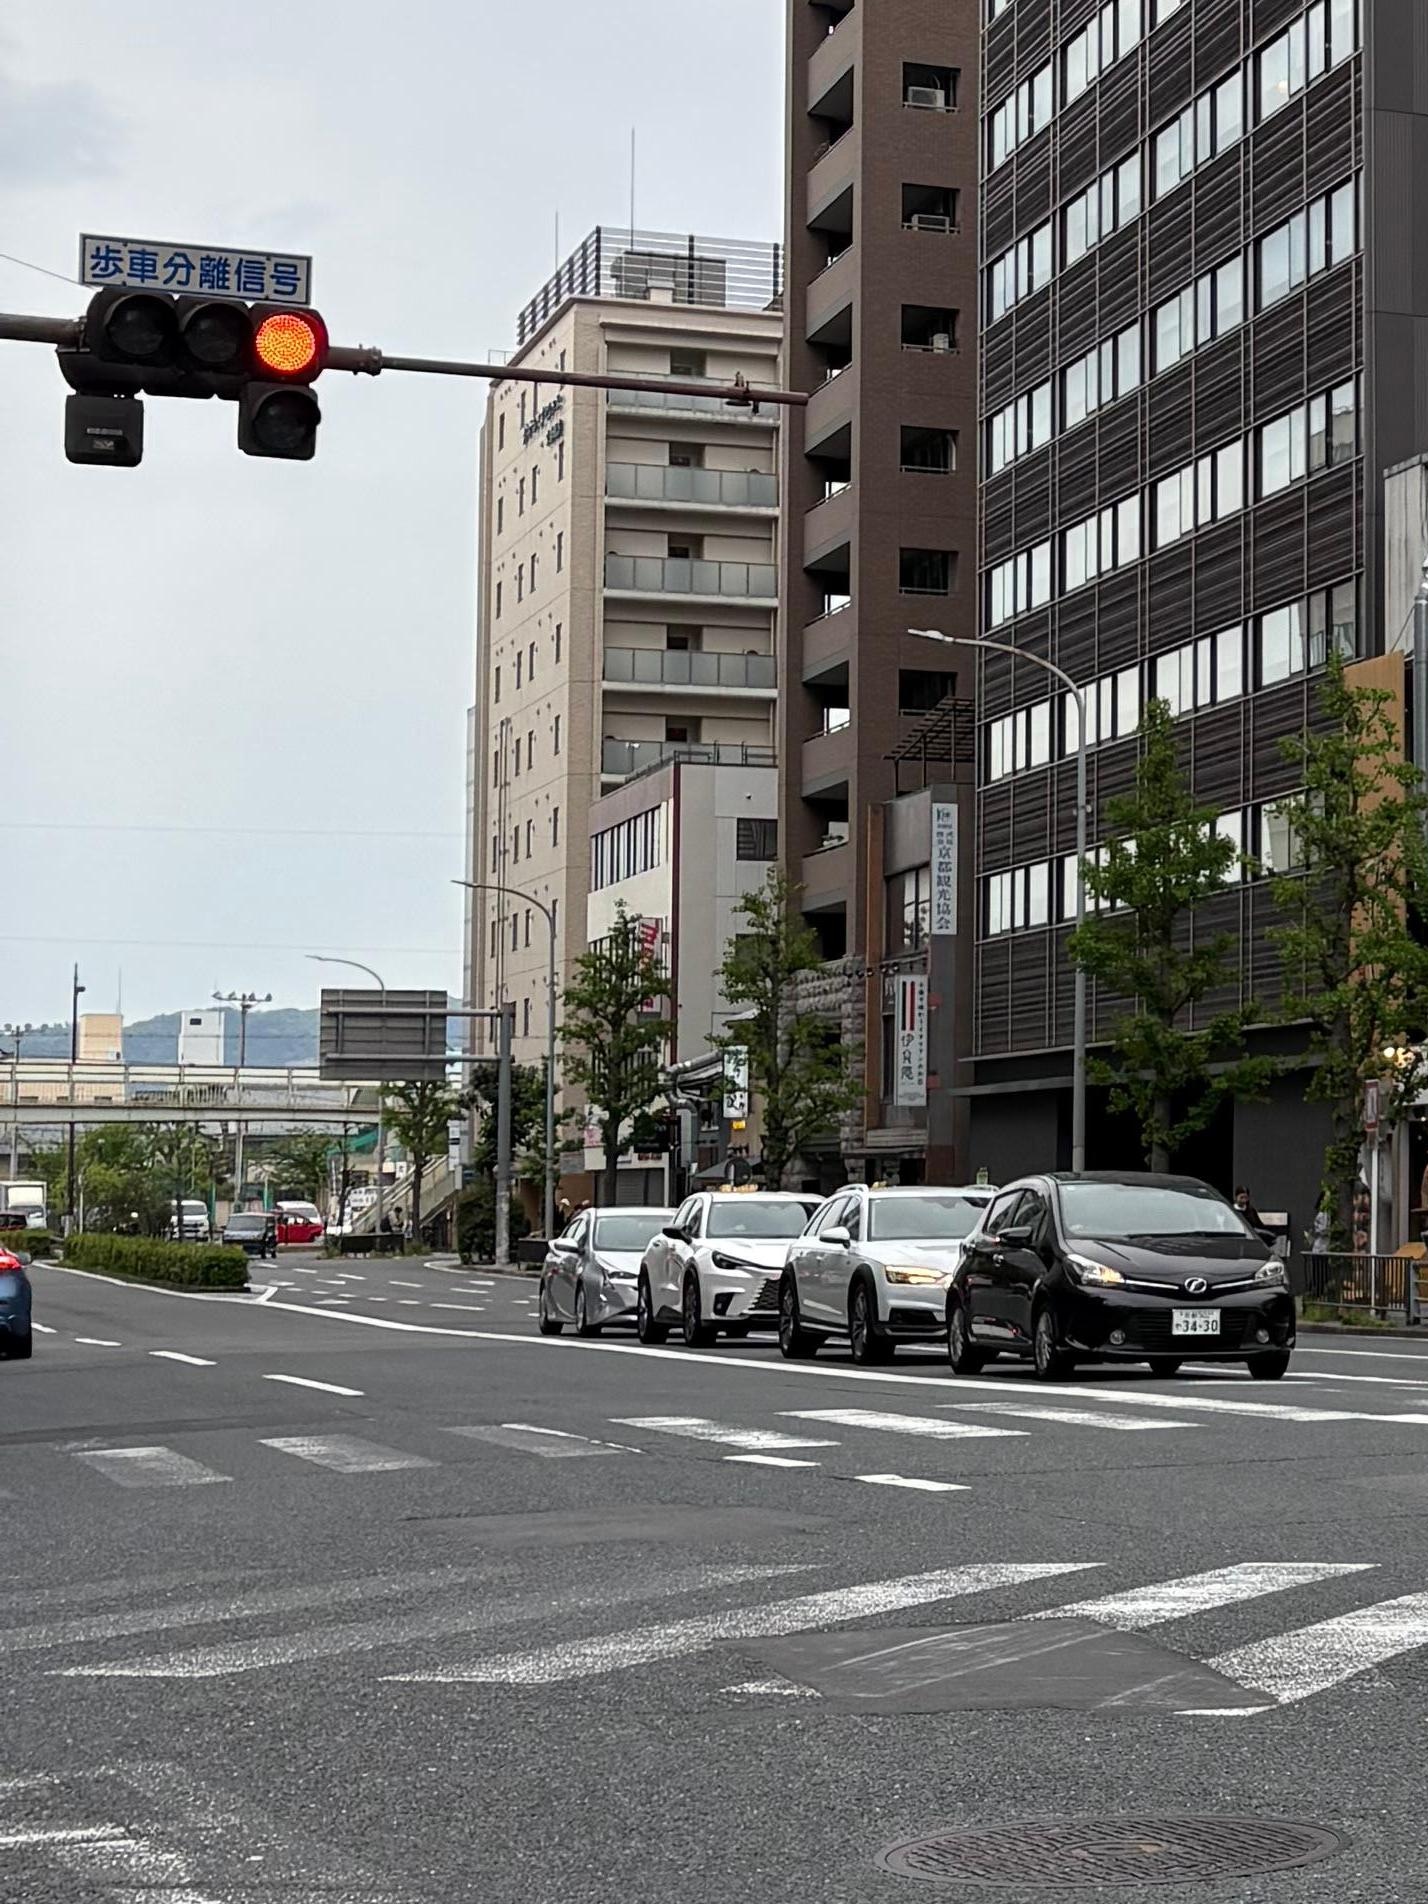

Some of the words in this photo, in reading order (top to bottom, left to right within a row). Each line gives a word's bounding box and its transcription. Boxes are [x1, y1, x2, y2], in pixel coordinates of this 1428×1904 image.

[90, 245, 301, 297] 歩車分離信号
